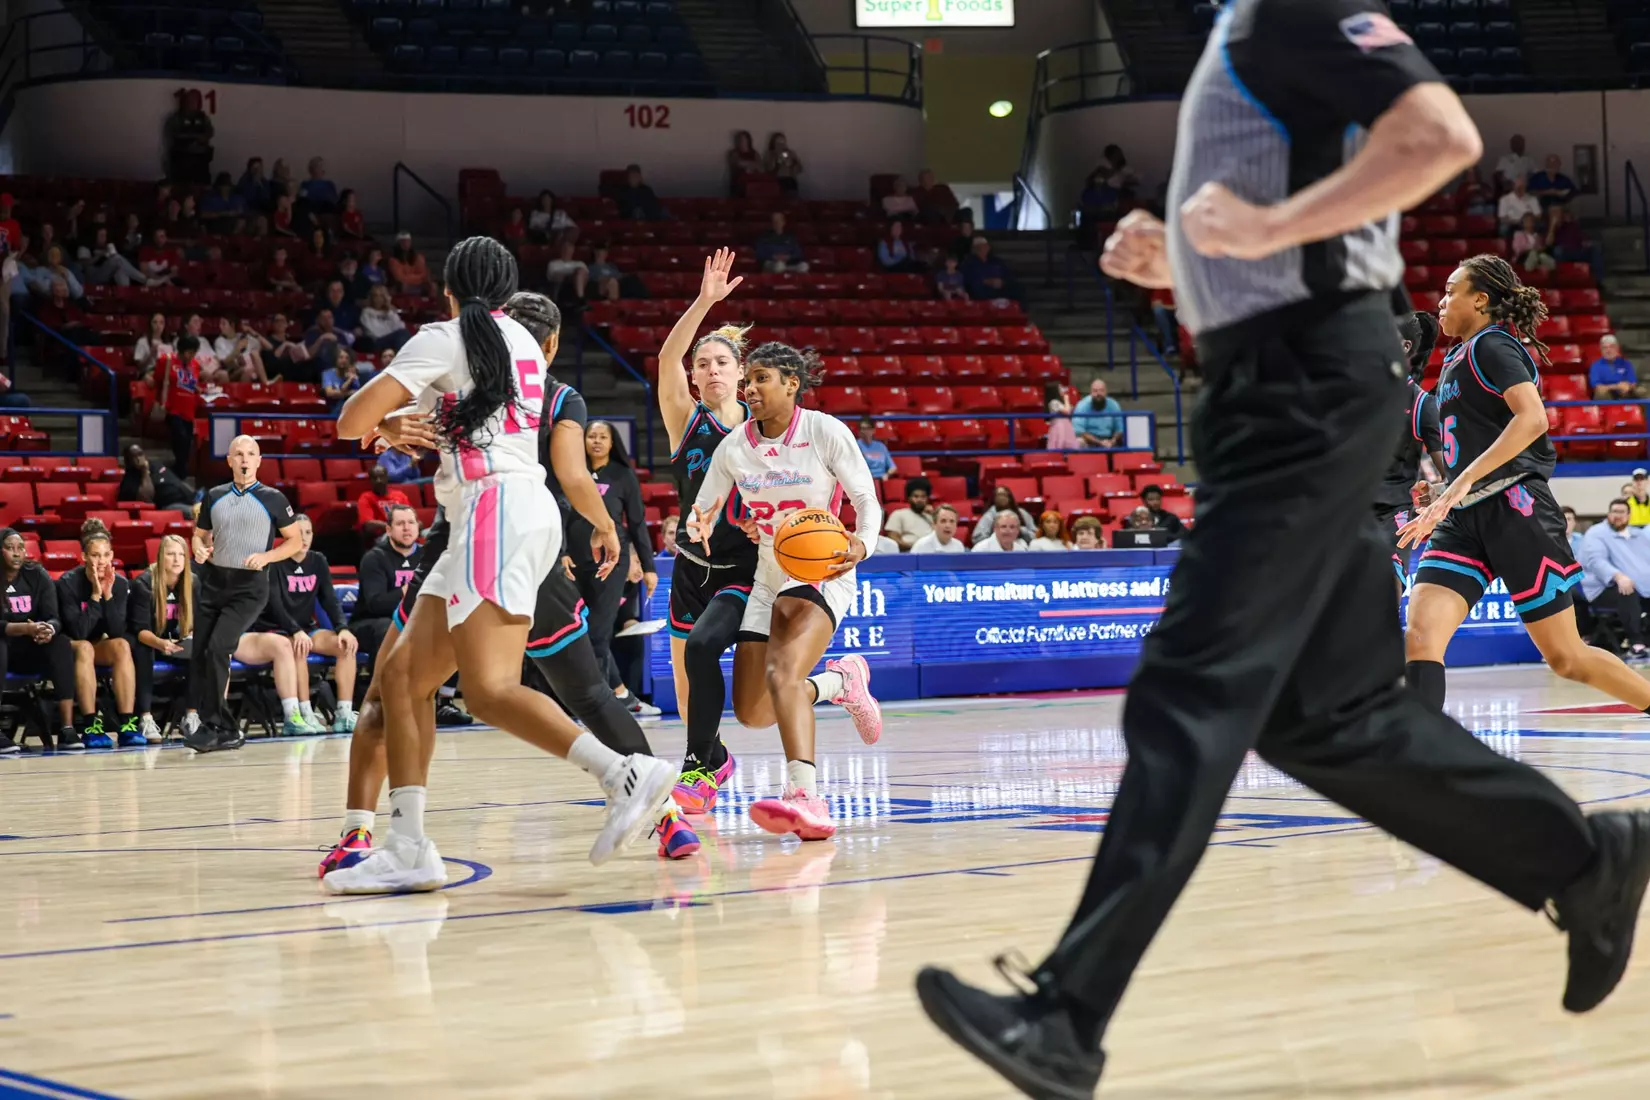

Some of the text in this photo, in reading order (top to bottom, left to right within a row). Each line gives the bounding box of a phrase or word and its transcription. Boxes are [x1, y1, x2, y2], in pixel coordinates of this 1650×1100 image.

[624, 104, 670, 129] 102
[1439, 415, 1459, 469] 5
[287, 574, 317, 593] FIU
[923, 584, 964, 603] Your
[966, 582, 1049, 603] Furniture,
[1052, 580, 1128, 599] Mattress
[1130, 577, 1160, 597] and
[976, 626, 1025, 644] Official
[1026, 625, 1086, 643] Furniture
[1088, 622, 1138, 640] Partner
